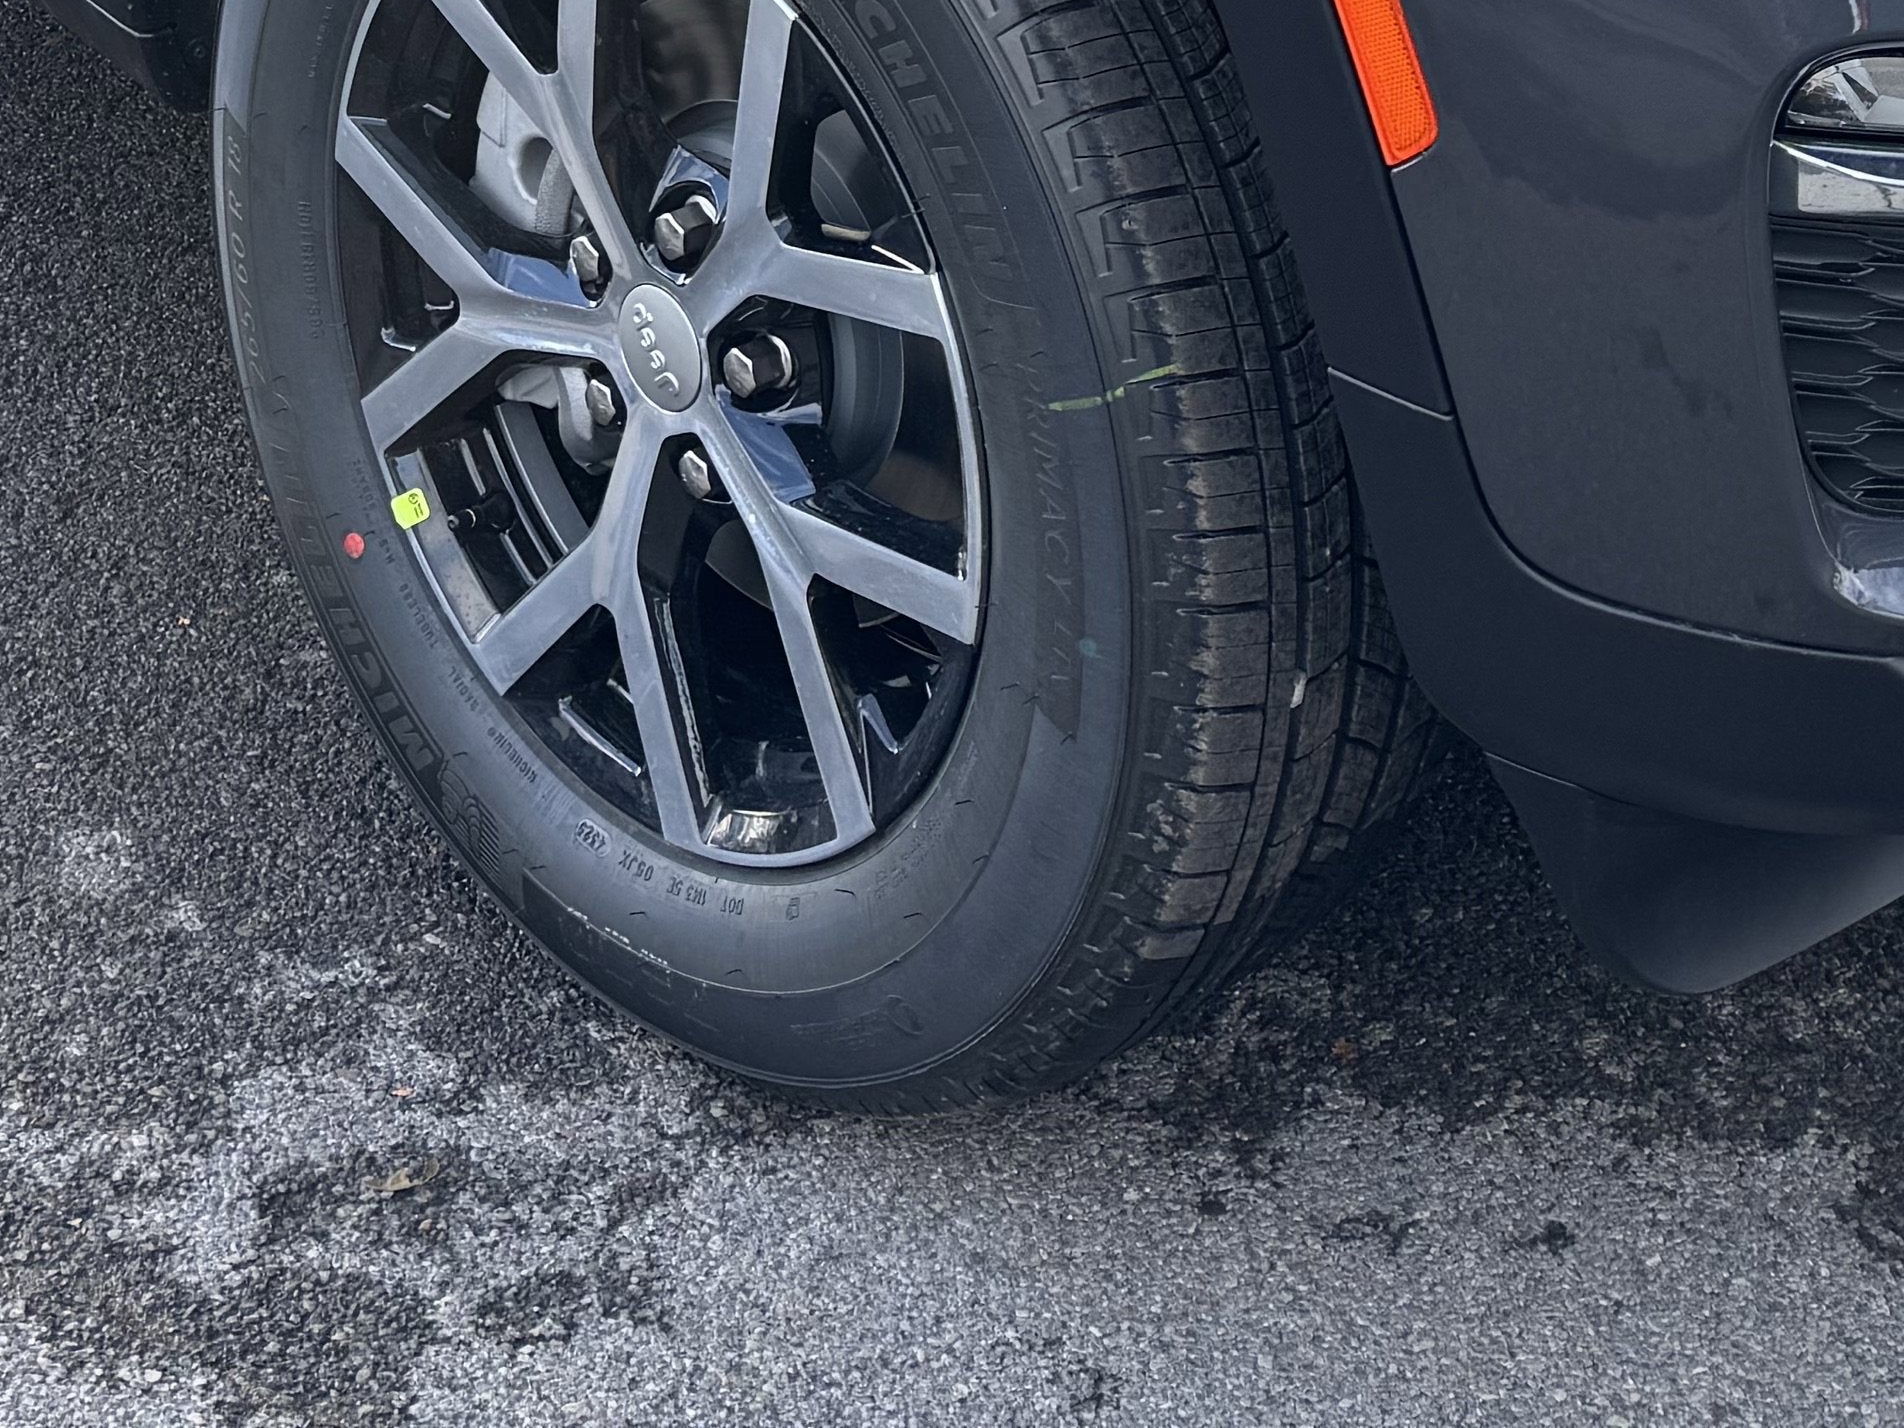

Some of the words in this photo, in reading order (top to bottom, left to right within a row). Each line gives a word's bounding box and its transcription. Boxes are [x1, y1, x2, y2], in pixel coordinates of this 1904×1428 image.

[227, 136, 242, 175] 18
[228, 190, 243, 221] R
[230, 232, 267, 384] 265/60
[632, 302, 680, 396] Jeep
[1015, 362, 1073, 606] PRIMACY
[268, 442, 436, 775] MICHELIN
[719, 895, 745, 916] DOT
